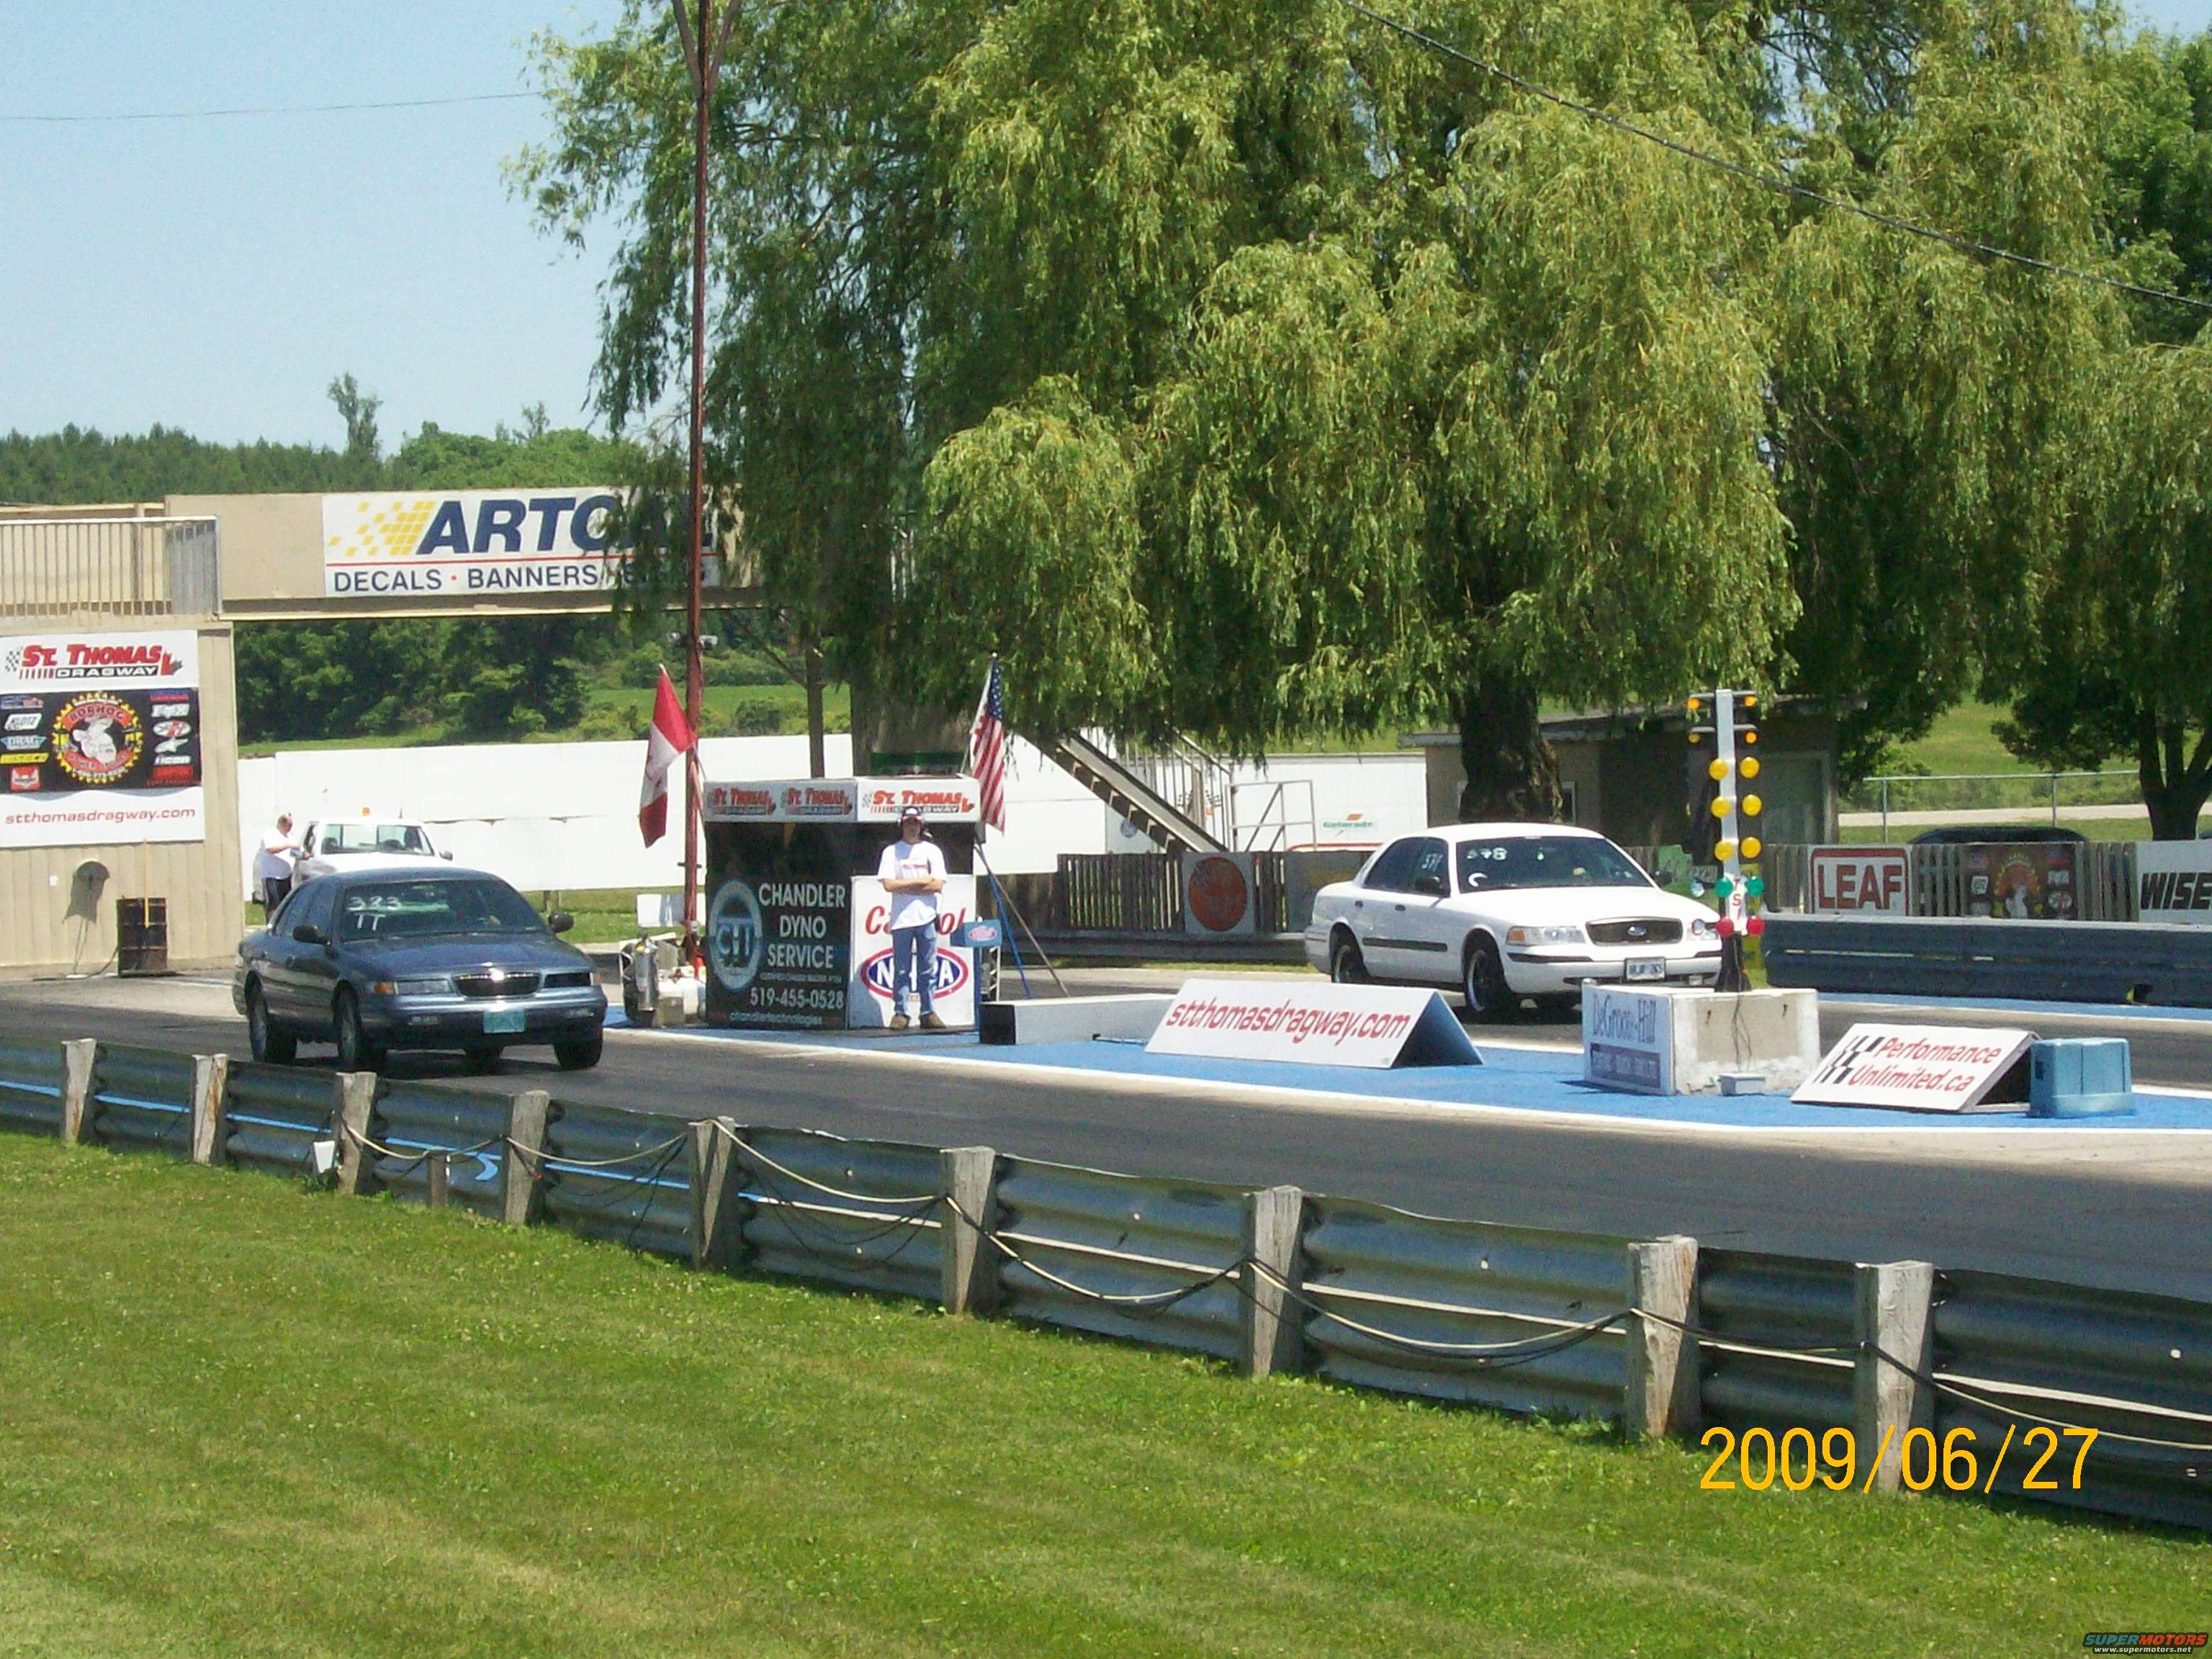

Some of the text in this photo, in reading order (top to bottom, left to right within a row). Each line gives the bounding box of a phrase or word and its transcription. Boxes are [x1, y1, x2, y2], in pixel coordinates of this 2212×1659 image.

[334, 568, 442, 593] DECALS
[467, 565, 598, 589] BANNERS
[66, 644, 163, 665] THOMAS
[57, 666, 158, 678] DRAGWAY
[901, 790, 963, 804] THOMAS
[5, 807, 197, 824] stthomasdragway.com
[758, 883, 846, 908] CHANDLER
[1817, 863, 1903, 909] LEAF
[779, 914, 827, 939] DYNO
[767, 943, 834, 969] SERVICE
[750, 986, 844, 1010] 519-455-0528
[1165, 997, 1411, 1046] stthomasdragway.com
[1874, 1038, 2002, 1064] Performance
[1847, 1064, 1976, 1092] Unlimited.ca
